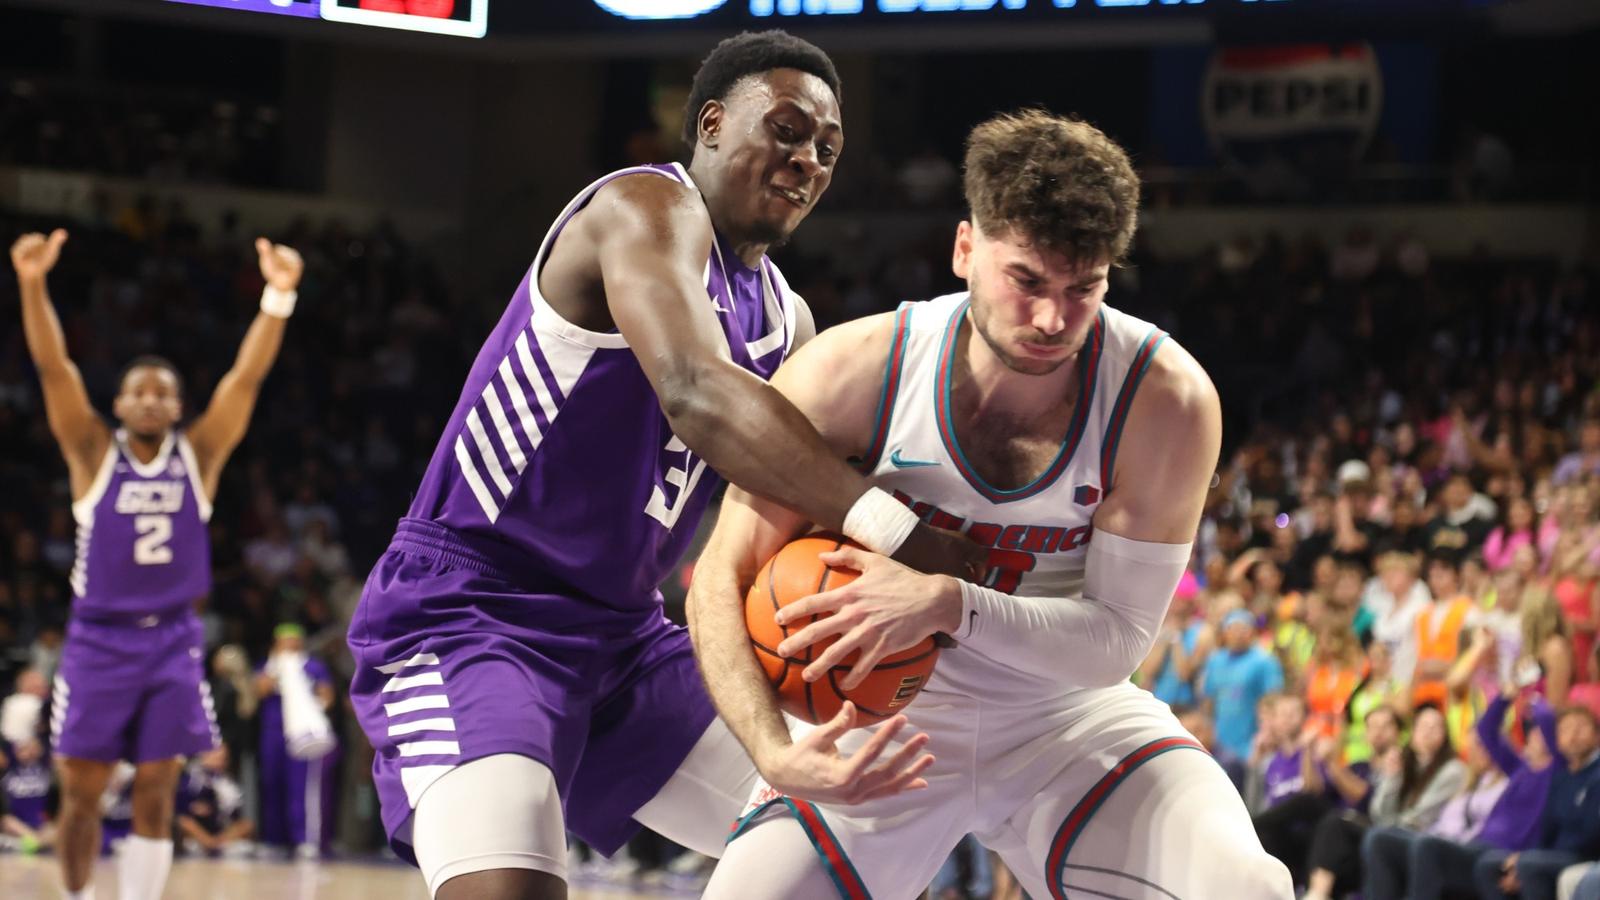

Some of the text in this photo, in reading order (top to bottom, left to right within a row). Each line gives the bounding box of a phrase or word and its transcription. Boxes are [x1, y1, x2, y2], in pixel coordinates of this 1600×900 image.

[1215, 79, 1370, 117] PEPSI
[114, 481, 185, 514] GCU
[133, 515, 174, 566] 2
